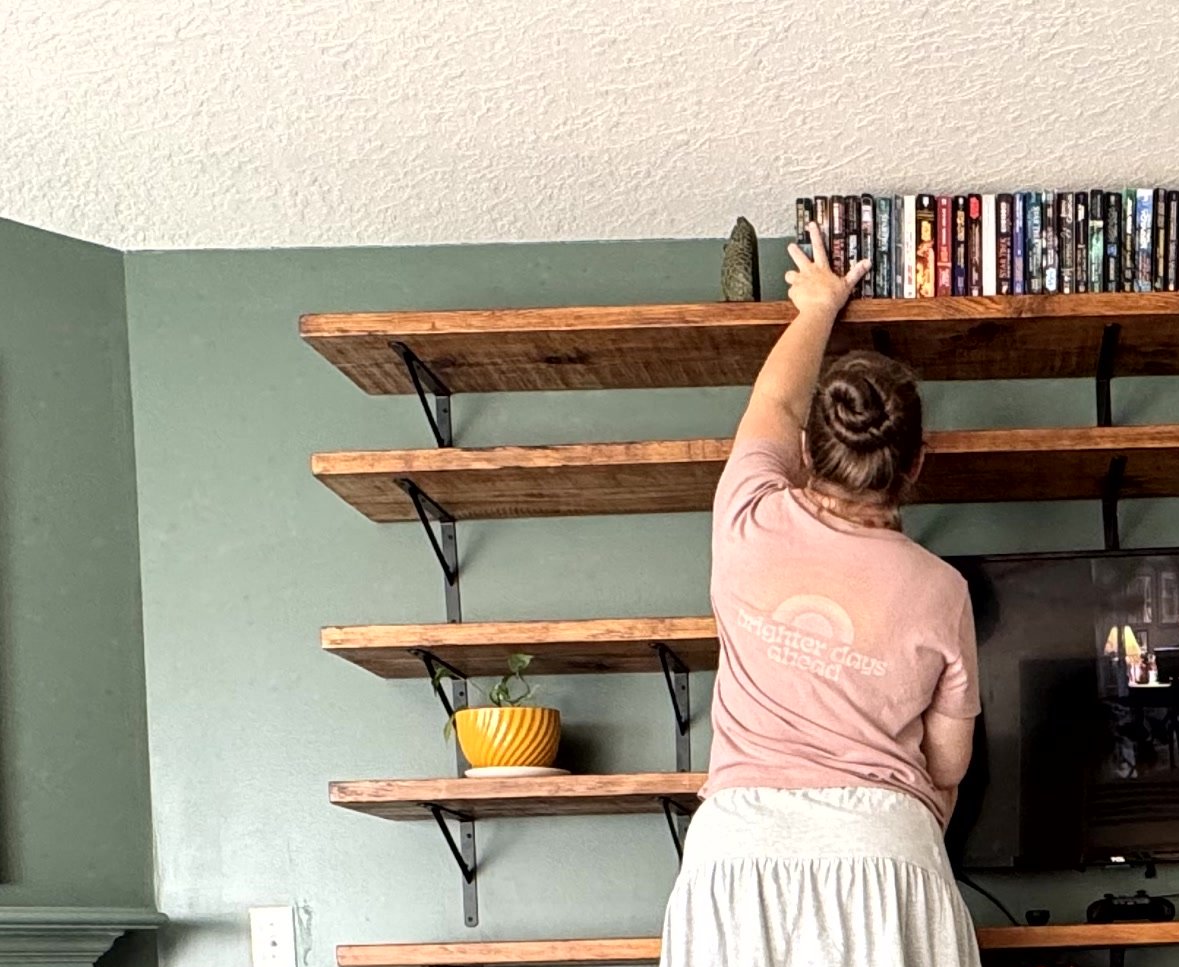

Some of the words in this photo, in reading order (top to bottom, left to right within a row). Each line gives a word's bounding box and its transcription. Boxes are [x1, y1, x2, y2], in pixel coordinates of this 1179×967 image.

[1031, 206, 1041, 225] STAR
[999, 237, 1007, 258] TREK
[999, 259, 1007, 278] STAR
[736, 608, 827, 656] brighter
[829, 644, 888, 677] days
[767, 644, 841, 682] ahead
